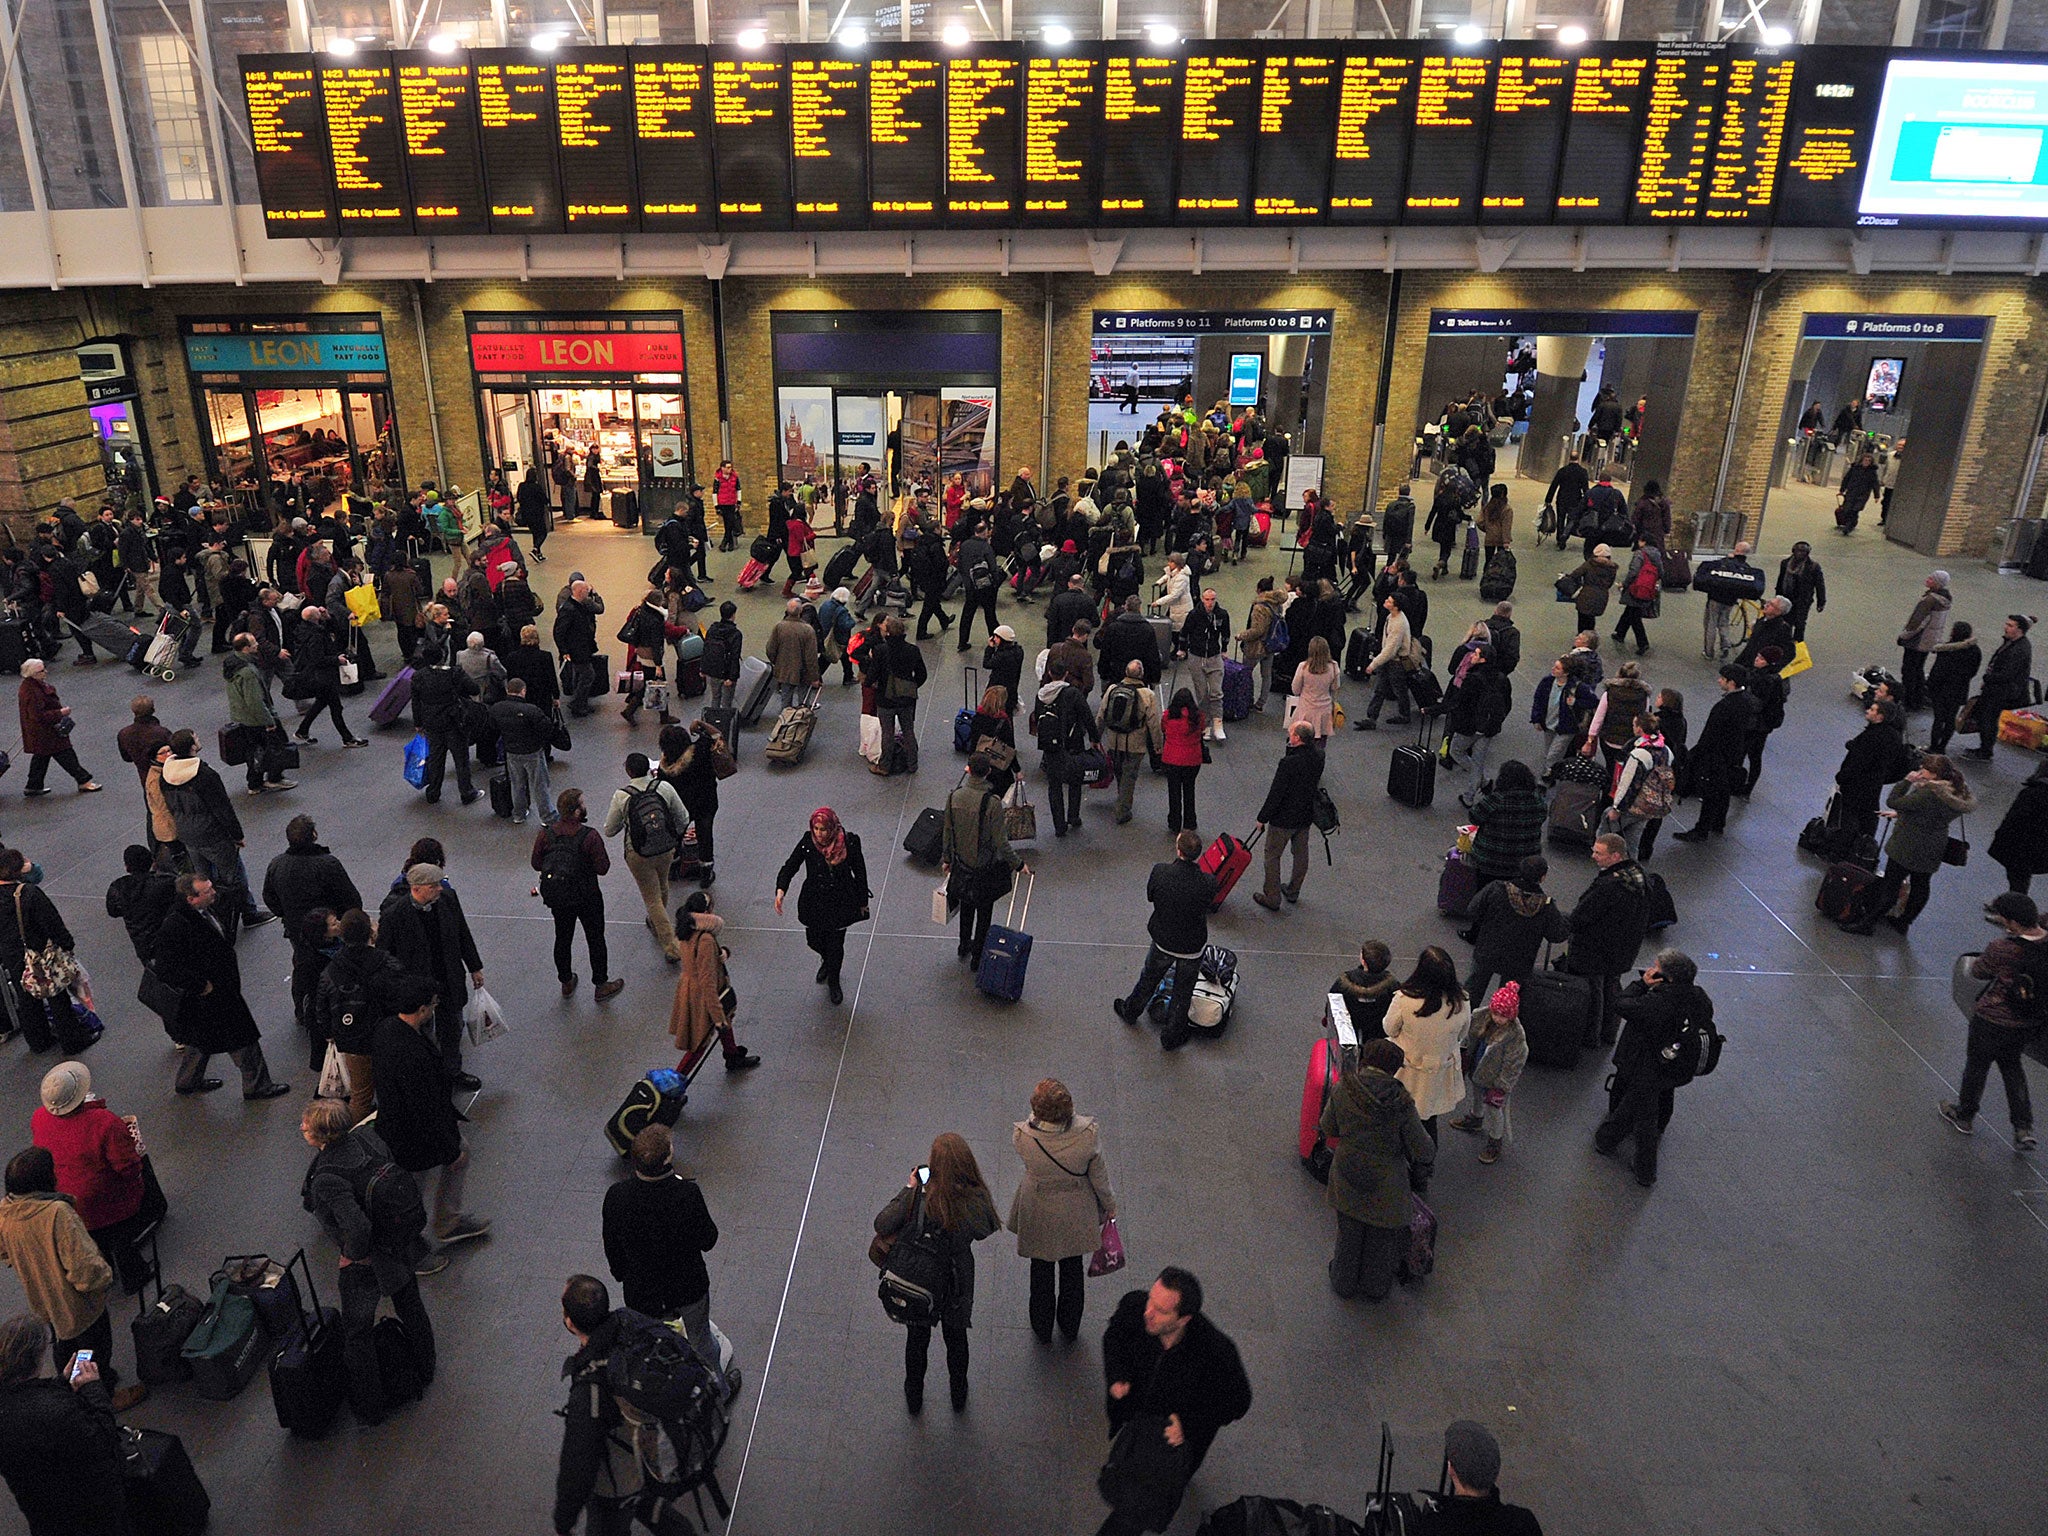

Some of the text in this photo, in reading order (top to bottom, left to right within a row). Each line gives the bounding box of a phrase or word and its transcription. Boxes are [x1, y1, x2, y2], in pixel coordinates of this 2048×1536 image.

[741, 61, 775, 71] Platform
[820, 61, 854, 70] Platform
[899, 60, 932, 69] Platform
[978, 59, 1011, 68] Platform
[1057, 59, 1090, 68] Platform
[1136, 58, 1170, 67] Platform
[1216, 57, 1249, 66] Platform
[1294, 57, 1327, 66] Platform
[1374, 57, 1406, 66] Platform
[1451, 57, 1484, 66] Platform
[1529, 58, 1561, 67] Platform
[427, 66, 460, 77] Platform
[478, 65, 539, 75] 14:35 Platform
[556, 64, 617, 74] 14:45 Platform
[663, 63, 696, 72] Platform
[1344, 68, 1380, 76] Aberdeen
[246, 72, 266, 81] 14:15
[273, 71, 305, 80] Platform
[322, 68, 390, 78] 14:23 Platform 11
[713, 72, 751, 82] Edinburgh
[792, 72, 829, 81] Newcastle
[870, 70, 908, 80] Cambridge
[948, 70, 1001, 80] Peterborough
[1059, 69, 1088, 78] Central
[1107, 69, 1130, 78] Leeds
[1186, 68, 1224, 78] Cambridge
[1421, 68, 1456, 77] Bradford
[1499, 68, 1522, 77] Leeds
[1576, 68, 1601, 77] Newark
[1601, 69, 1622, 77] North
[400, 77, 437, 86] Newcastle
[478, 76, 502, 85] Leeds
[556, 75, 594, 84] Cambridge
[634, 73, 669, 83] Bradford
[246, 82, 283, 91] Cambridge
[323, 79, 374, 89] Peterborough
[949, 201, 967, 210] First
[968, 201, 981, 211] Cap
[1026, 200, 1067, 209] East Coast
[1102, 199, 1143, 208] East Coast
[1179, 199, 1196, 208] First
[1197, 199, 1211, 208] Cap
[1255, 198, 1295, 208] Hull Trains
[1331, 198, 1372, 206] East Coast
[1407, 198, 1459, 206] Grand Central
[1483, 197, 1524, 206] East Coast
[1558, 197, 1599, 206] East Coast
[492, 206, 534, 215] East Coast
[568, 205, 586, 214] First
[587, 205, 600, 214] Cap
[644, 204, 696, 213] Grand Central
[720, 203, 762, 212] East Coast
[796, 202, 838, 212] East Coast
[873, 202, 891, 210] First
[892, 202, 905, 211] Cap
[267, 211, 285, 219] First
[286, 210, 298, 219] Cap
[342, 209, 359, 217] First
[360, 209, 373, 217] Cap
[417, 207, 458, 216] East Coast
[1857, 216, 1900, 227] JCDecaux
[1130, 318, 1210, 327] Platforms 9 to 11
[1224, 318, 1296, 327] Platforms 0 to 8
[1863, 322, 1944, 333] Platforms 0 to 8
[249, 340, 322, 365] LEON
[476, 344, 525, 352] NATURALLY
[539, 339, 615, 365] LEON
[101, 387, 121, 396] Tickets
[1710, 570, 1755, 582] HEAD
